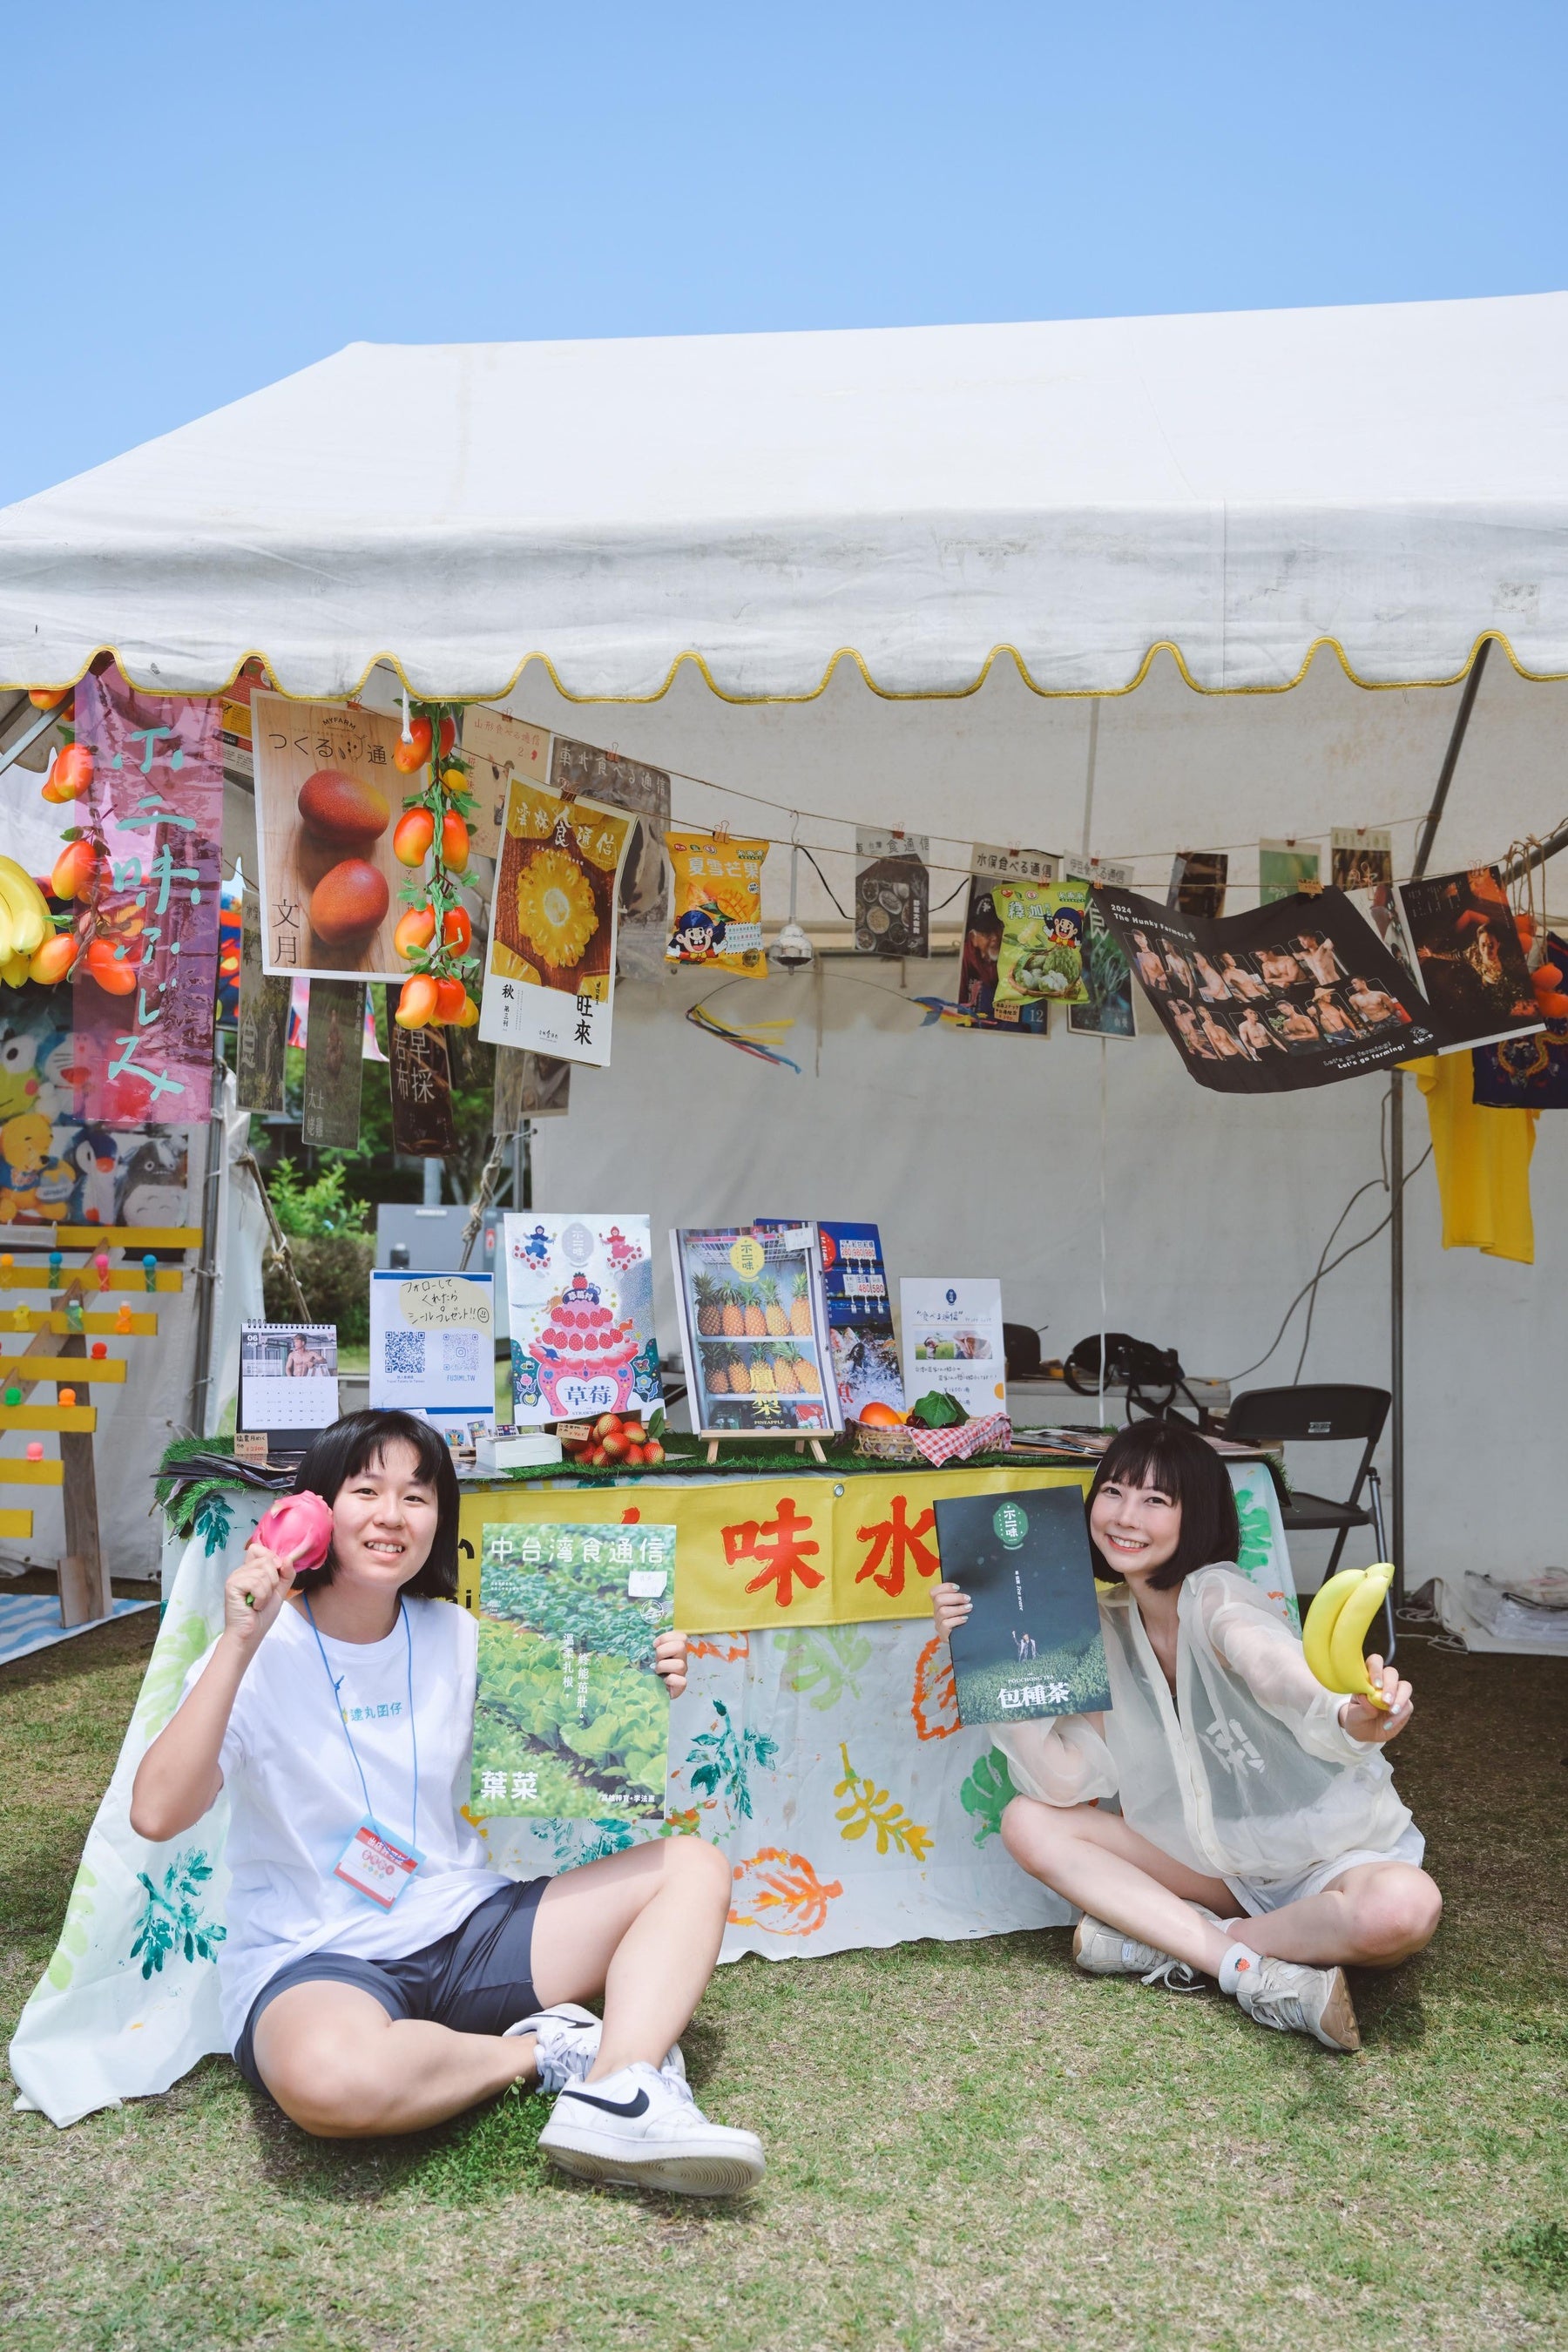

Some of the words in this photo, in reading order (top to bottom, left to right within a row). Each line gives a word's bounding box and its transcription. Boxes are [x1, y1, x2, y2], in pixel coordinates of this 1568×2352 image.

[322, 717, 357, 731] MYFARM
[687, 856, 760, 879] 夏雪芒果
[1110, 903, 1132, 915] 2024
[271, 899, 301, 964] 文月
[1113, 912, 1130, 923] The
[1132, 916, 1159, 929] Hunky
[1159, 923, 1189, 940] Farmers
[502, 983, 515, 1000] 秋
[573, 994, 593, 1045] 旺來
[1031, 1009, 1044, 1023] 12
[1337, 1059, 1358, 1070] Let's
[1359, 1056, 1370, 1064] go
[1371, 1044, 1406, 1059] farming!
[740, 1244, 754, 1271] 不二味
[402, 1279, 453, 1294] フォローして
[858, 1283, 870, 1293] 480
[872, 1284, 884, 1294] 580
[422, 1290, 458, 1308] くれたら
[564, 1385, 612, 1406] 草莓
[749, 1369, 782, 1416] 鳳梨
[1003, 1509, 1020, 1538] 不二味
[996, 1681, 1071, 1709] 包種茶
[480, 1770, 538, 1801] 葉菜
